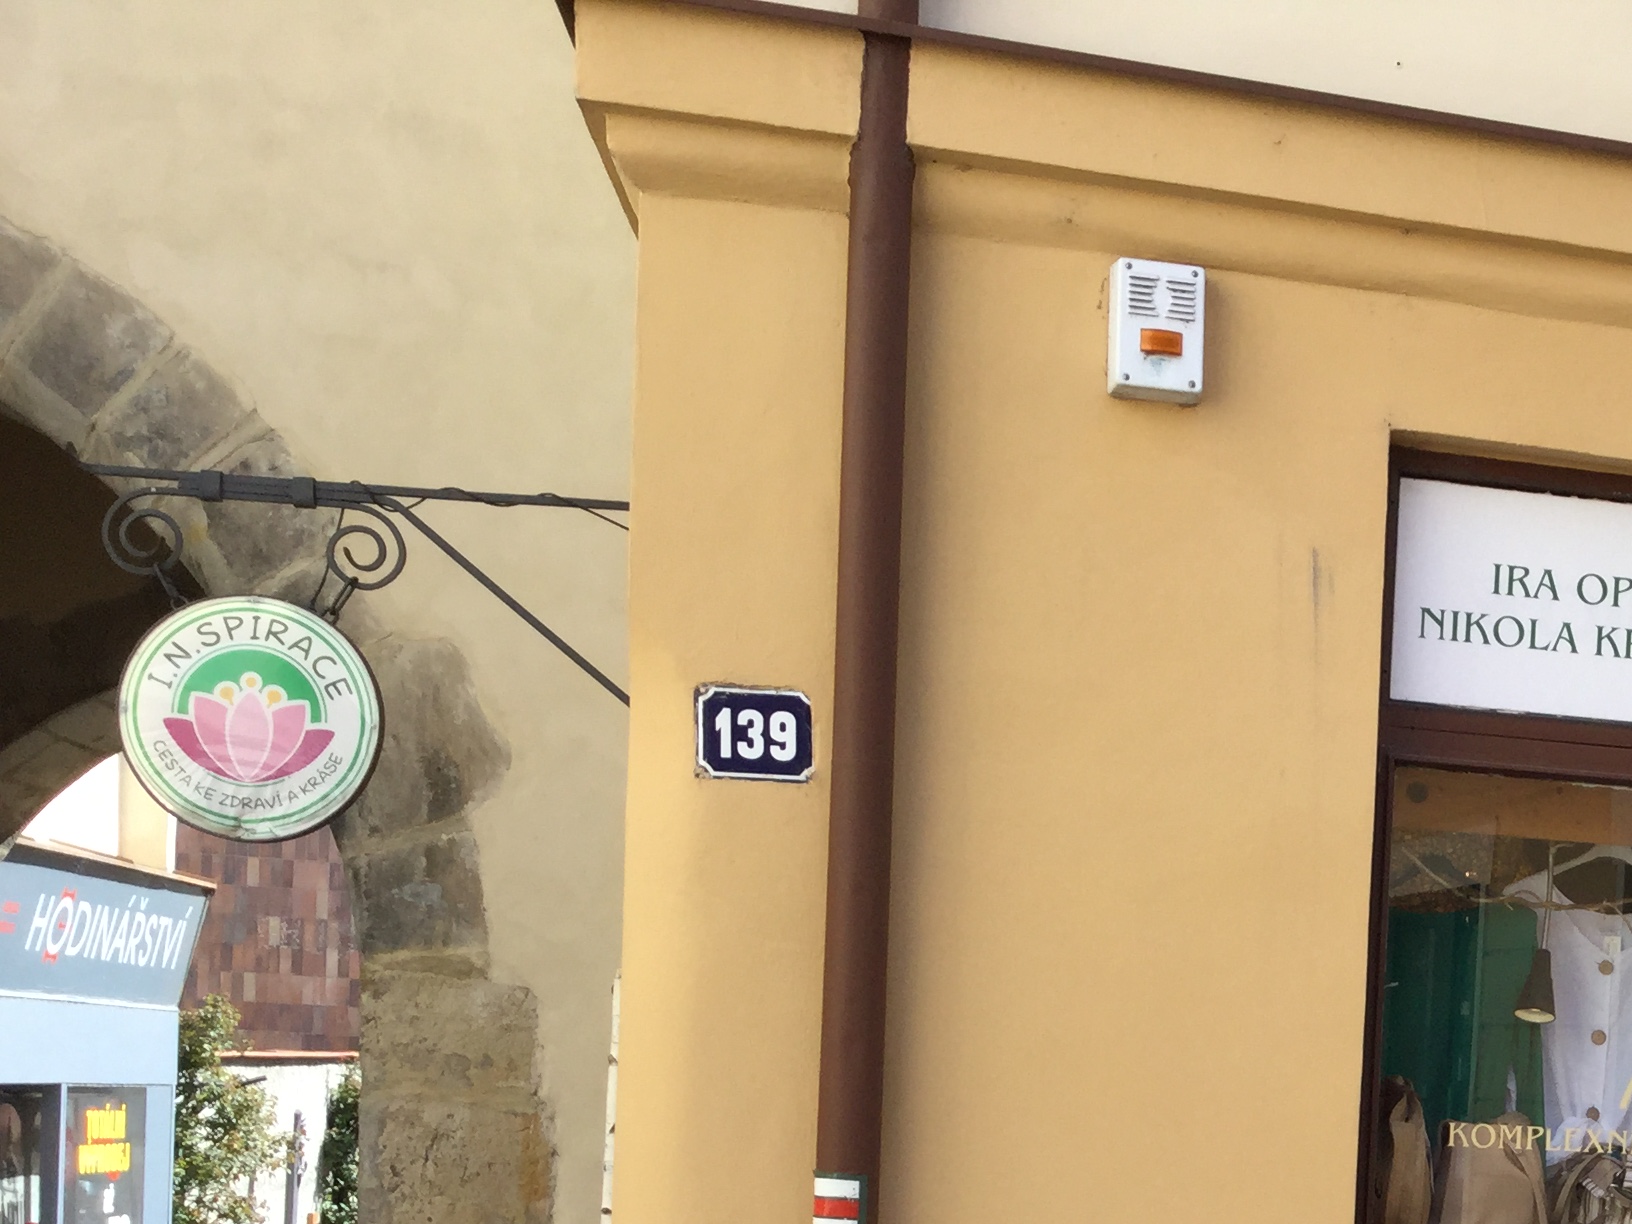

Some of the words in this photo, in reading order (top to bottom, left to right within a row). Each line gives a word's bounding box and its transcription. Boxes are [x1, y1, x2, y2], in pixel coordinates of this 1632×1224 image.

[1490, 562, 1561, 602] IRA
[147, 615, 354, 701] I.N.SPIRACE
[1417, 606, 1578, 655] NIKOLA
[715, 707, 797, 762] 139
[153, 739, 192, 788] CESTA
[193, 781, 218, 801] KE
[218, 790, 284, 811] ZDRAVÍ
[287, 789, 300, 805] A
[298, 751, 343, 796] KRÁSE
[25, 893, 194, 970] HODINÁŘSTVÍ
